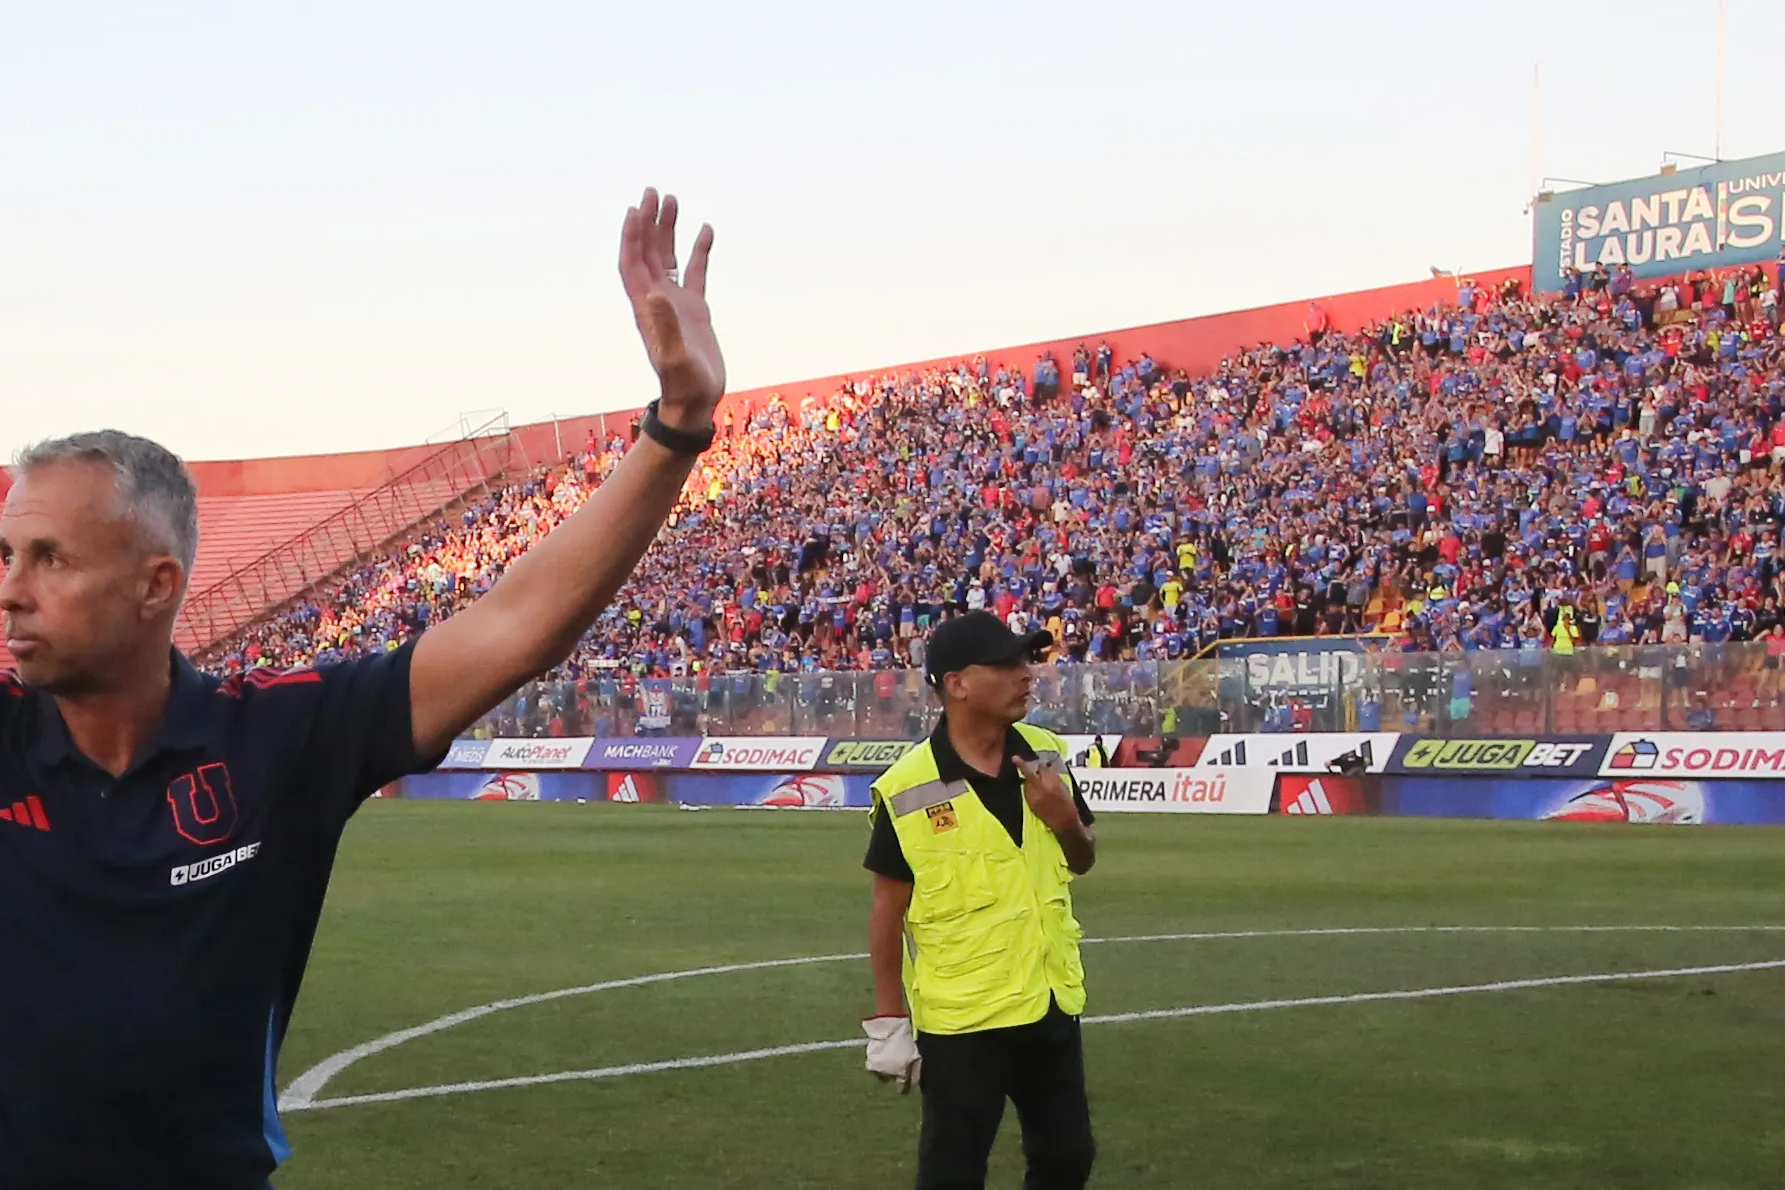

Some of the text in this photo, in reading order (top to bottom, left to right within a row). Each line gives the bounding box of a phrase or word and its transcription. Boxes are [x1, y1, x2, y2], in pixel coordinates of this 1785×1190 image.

[1575, 187, 1715, 239] SANTA
[1726, 192, 1785, 248] S
[1574, 221, 1714, 273] LAURA
[1247, 650, 1362, 687] SALID
[499, 743, 572, 759] AutoPlanet
[604, 743, 679, 758] MACHBANK
[722, 747, 809, 765] SODIMAC
[1661, 748, 1785, 771] SODIM
[1079, 779, 1166, 802] PRIMERA
